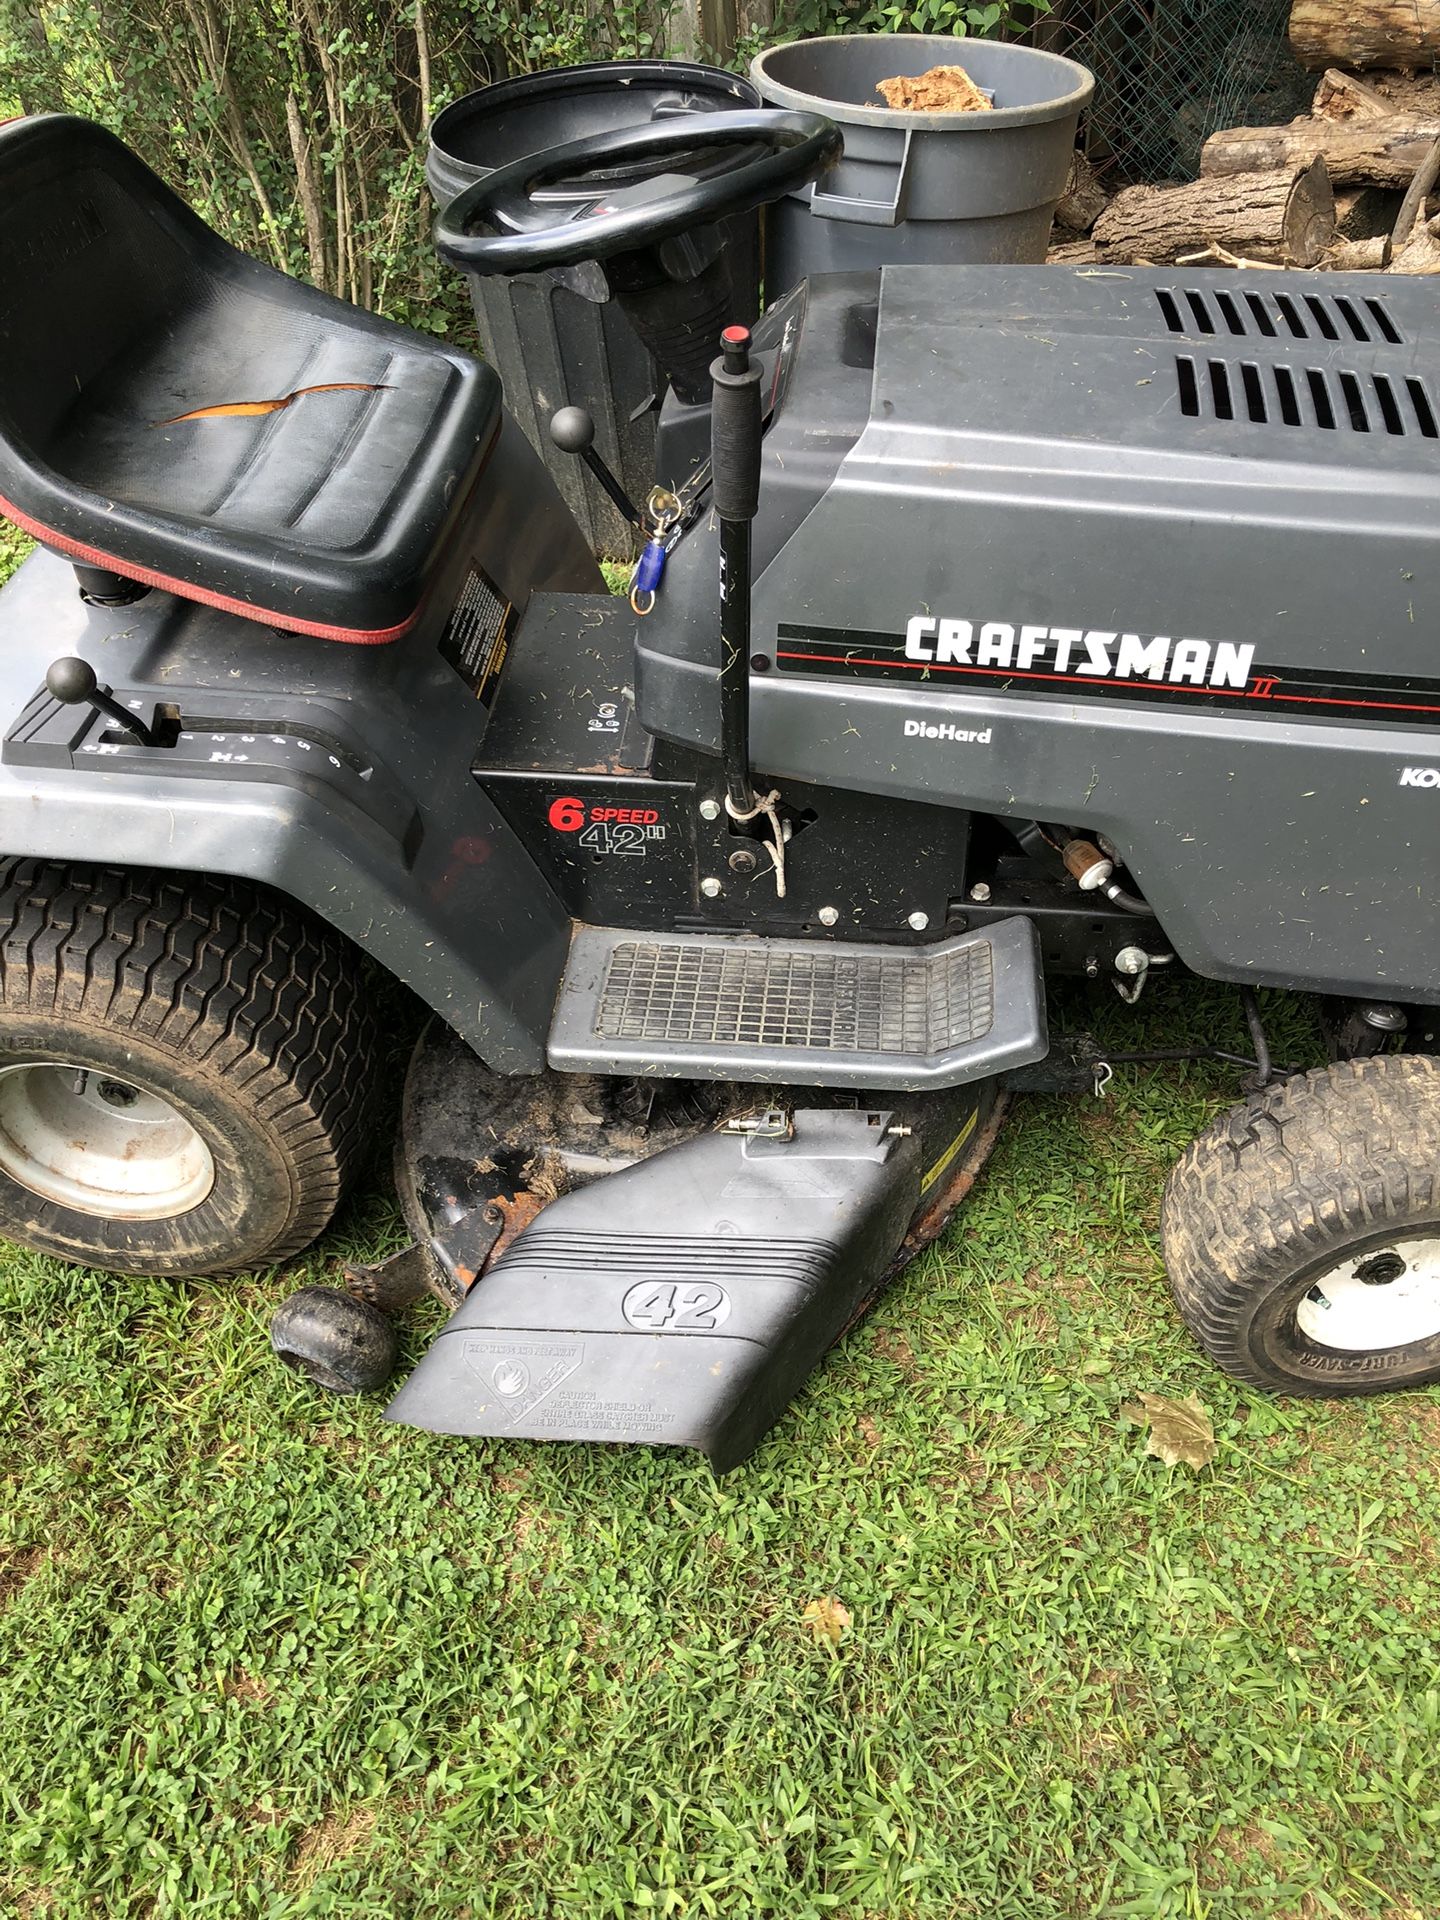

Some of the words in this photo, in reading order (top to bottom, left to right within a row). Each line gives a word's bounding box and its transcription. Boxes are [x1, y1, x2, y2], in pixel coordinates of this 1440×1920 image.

[905, 616, 1256, 688] CRAFTSMAN
[1245, 677, 1280, 698] II
[903, 720, 992, 744] DieHard
[297, 740, 311, 751] 5
[1400, 767, 1440, 788] KO
[549, 797, 585, 832] 6
[589, 806, 659, 825] SPEED
[579, 822, 666, 856] 42"
[632, 1284, 724, 1329] 42
[1299, 1351, 1410, 1372] TURF-SAVER
[510, 1359, 570, 1417] DANGER
[558, 1391, 596, 1401] CAUTION
[549, 1400, 603, 1411] DEFLECTOR
[604, 1402, 634, 1412] SHIELD
[546, 1418, 557, 1428] IN
[558, 1419, 590, 1429] PLACE
[622, 1421, 663, 1432] MOWING
[605, 1411, 649, 1422] CATCHER
[650, 1412, 676, 1423] MUST
